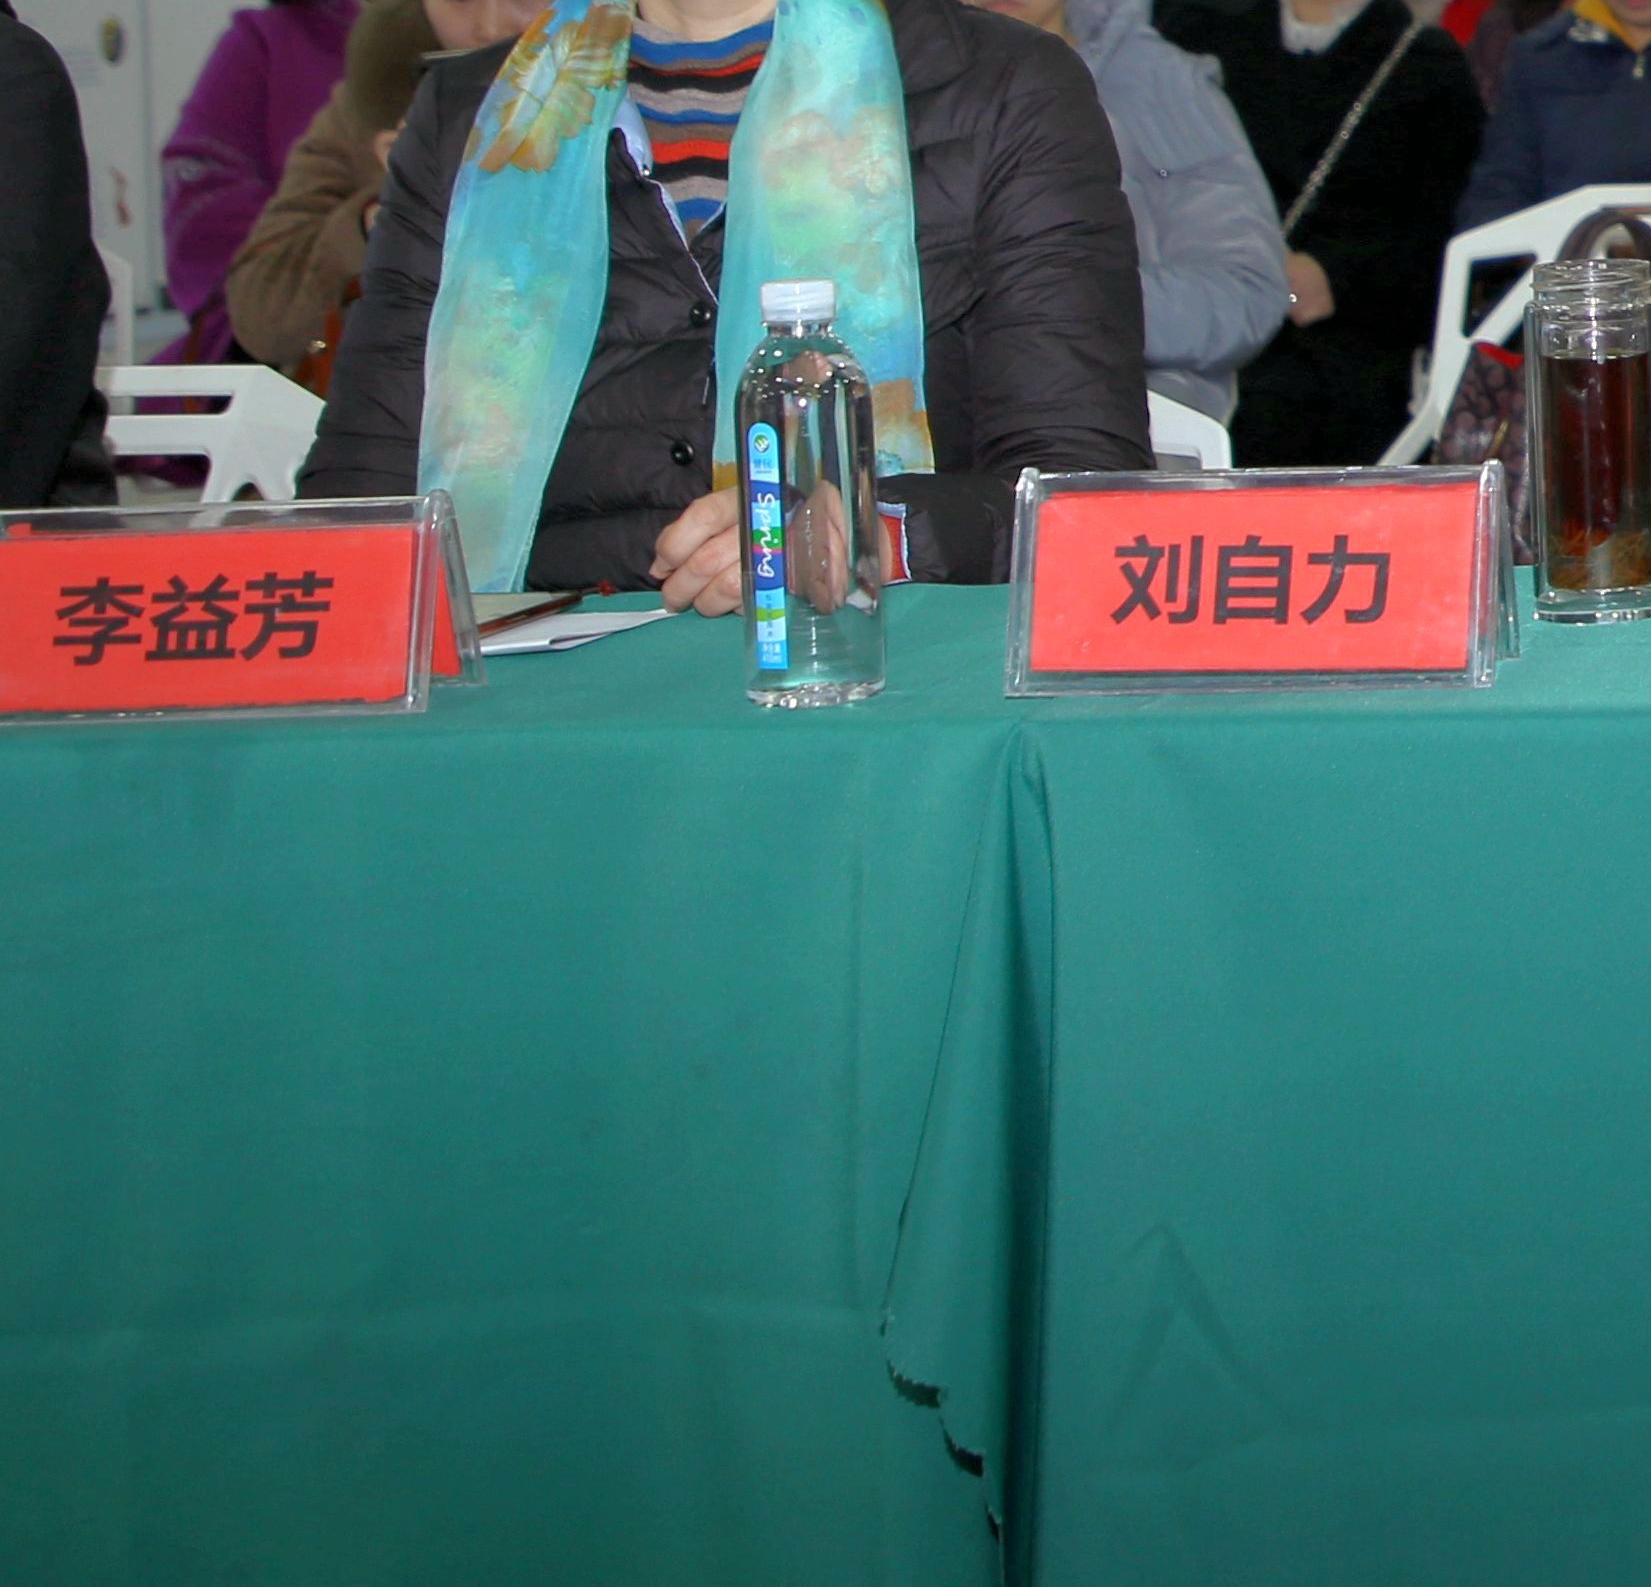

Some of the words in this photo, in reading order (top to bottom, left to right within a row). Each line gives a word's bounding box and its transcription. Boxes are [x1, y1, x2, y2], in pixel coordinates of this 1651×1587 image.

[757, 493, 776, 577] Spring
[1110, 534, 1391, 624] 刘自力
[53, 571, 333, 665] 李益芳
